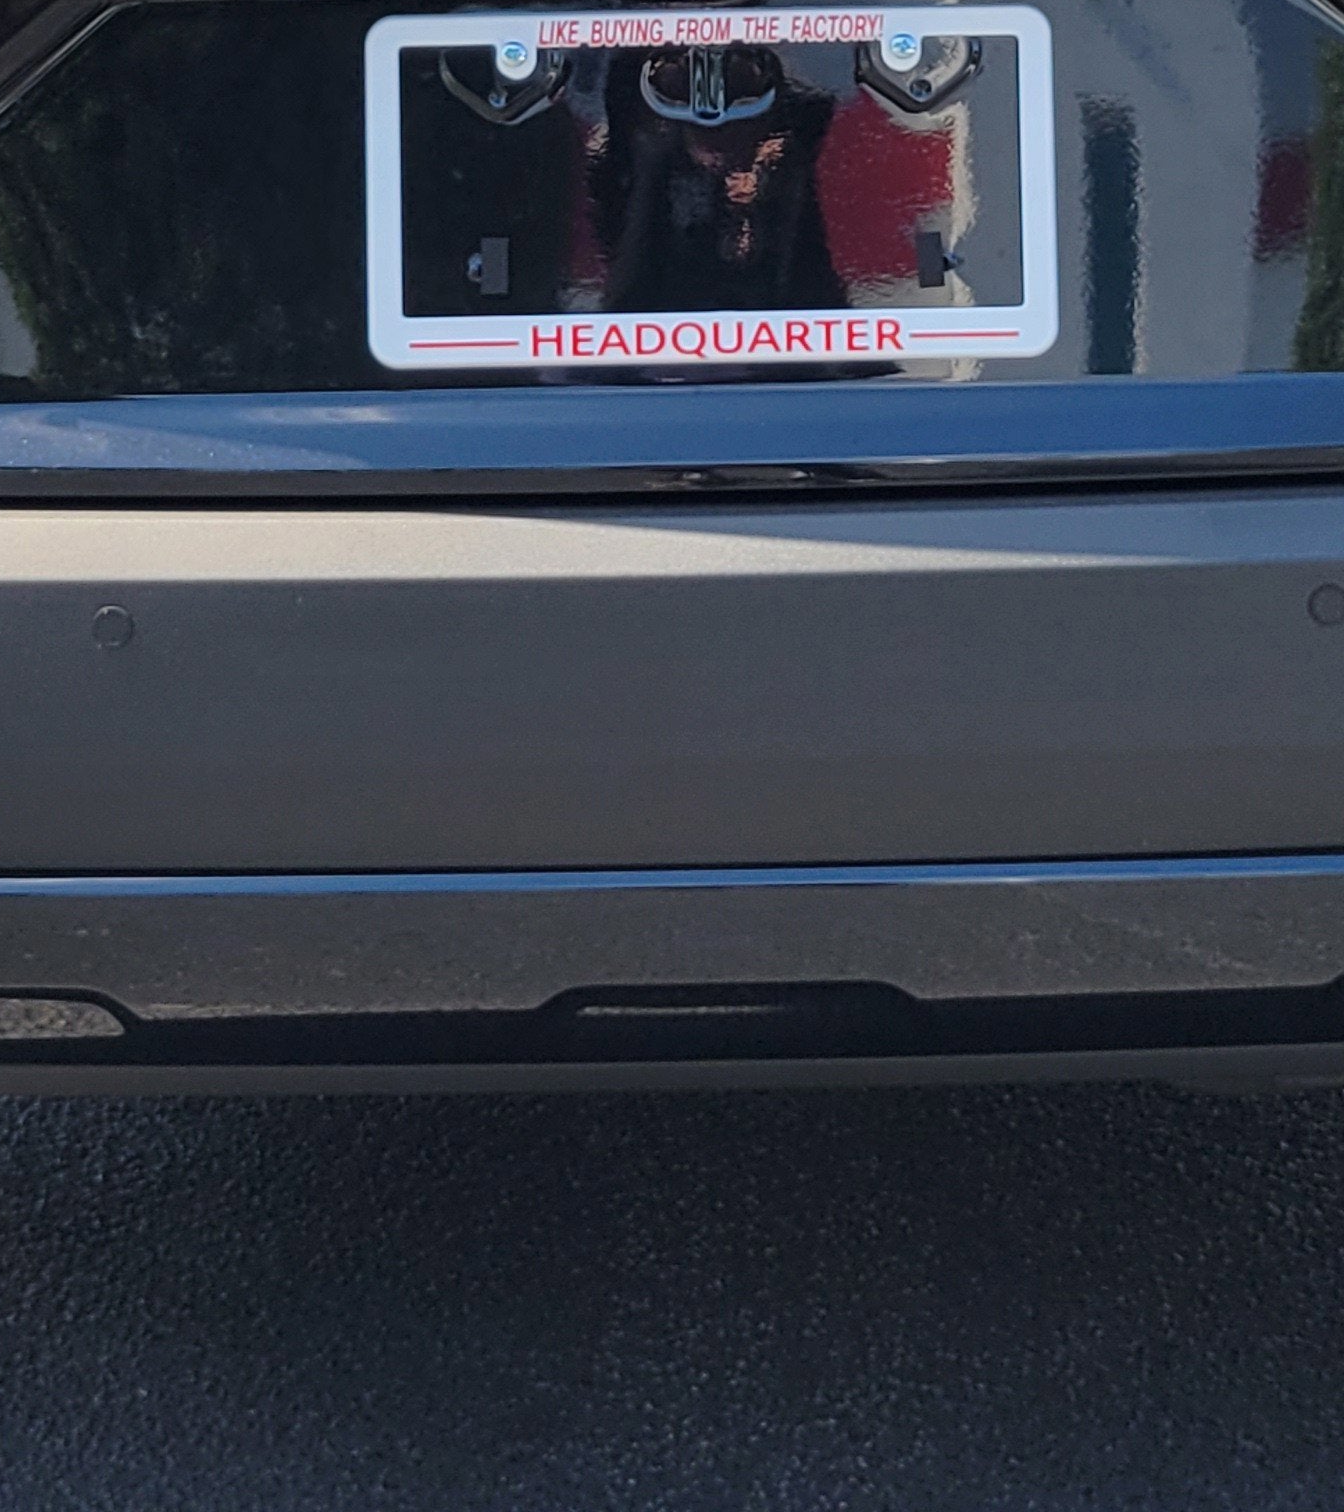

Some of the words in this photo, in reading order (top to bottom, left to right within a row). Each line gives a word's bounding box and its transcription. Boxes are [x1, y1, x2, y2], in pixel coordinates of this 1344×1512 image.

[538, 20, 580, 45] LIKE
[591, 18, 663, 44] BUYING
[676, 17, 731, 42] FROM
[743, 16, 780, 40] THE
[791, 14, 884, 39] FACTORY!
[531, 319, 904, 358] HEADQUARTER
